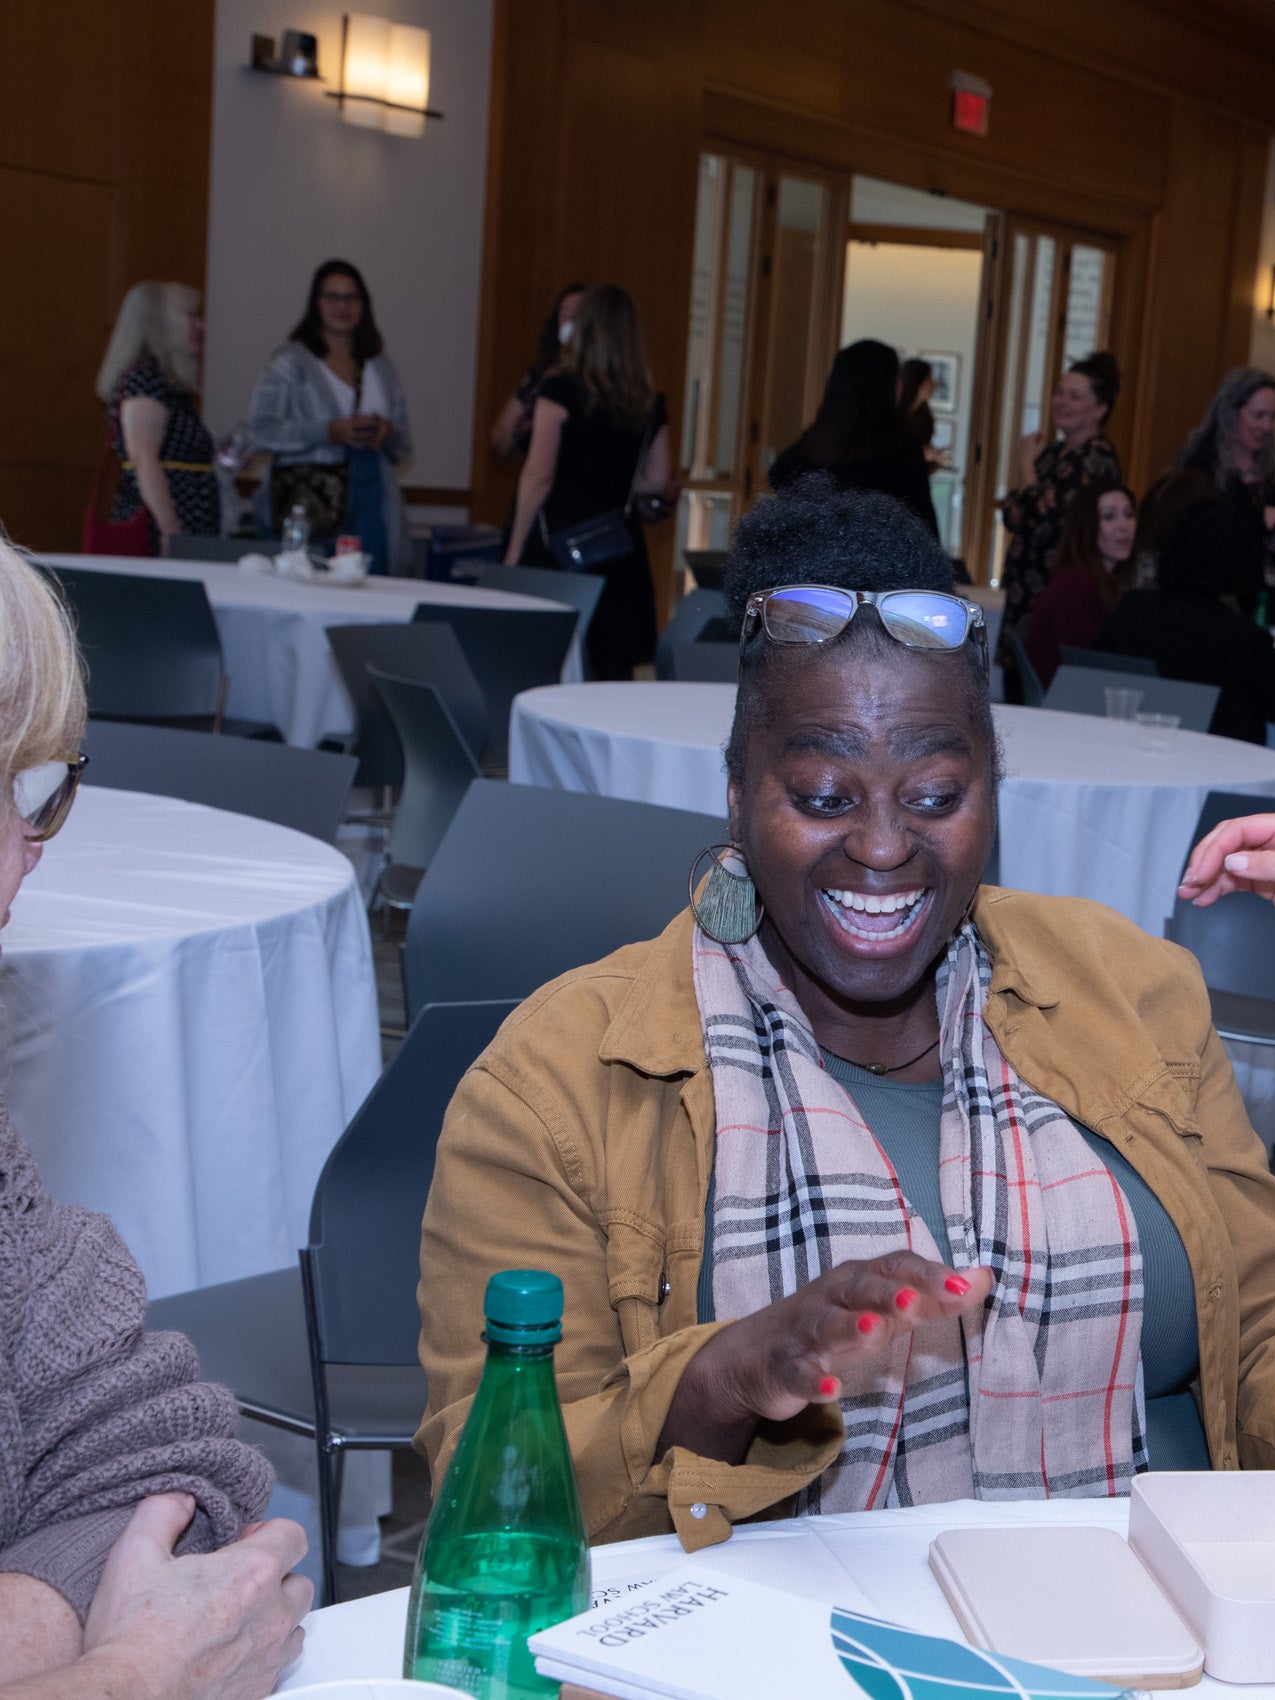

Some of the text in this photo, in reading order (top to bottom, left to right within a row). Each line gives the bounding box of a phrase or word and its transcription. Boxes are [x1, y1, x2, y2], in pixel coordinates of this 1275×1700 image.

[660, 1581, 701, 1602] LAW
[576, 1600, 661, 1637] SCHOOL
[599, 1587, 730, 1647] HARVARD
